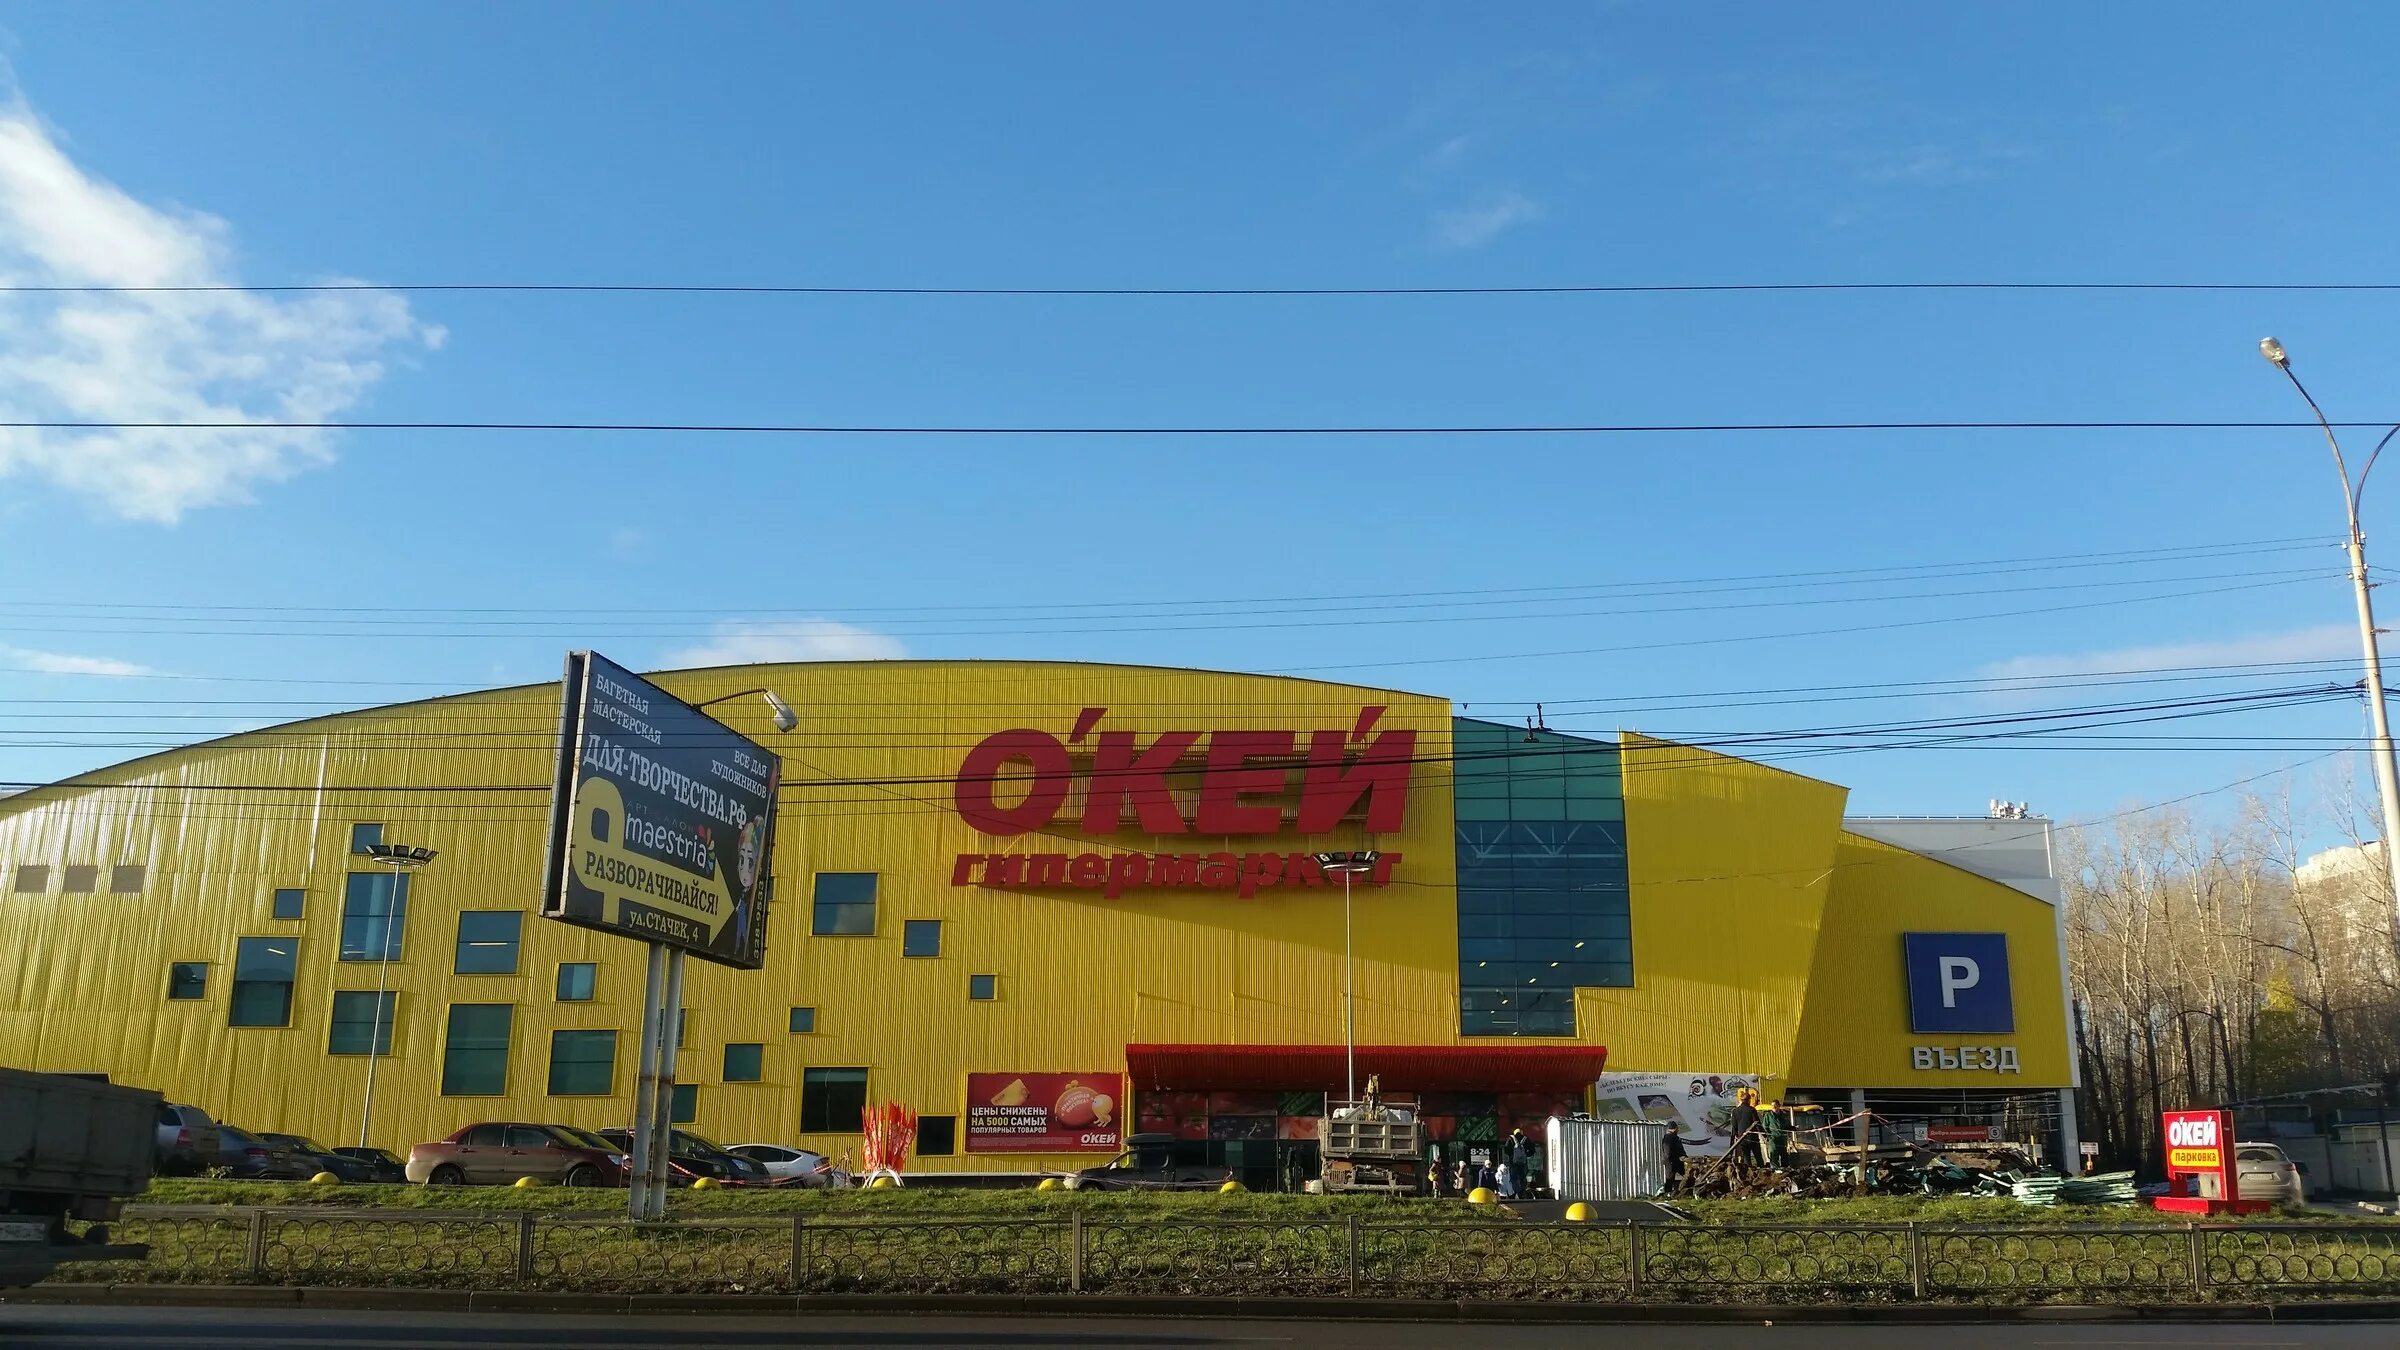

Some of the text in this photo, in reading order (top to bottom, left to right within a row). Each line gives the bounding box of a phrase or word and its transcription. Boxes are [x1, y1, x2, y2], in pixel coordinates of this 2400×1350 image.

[596, 674, 649, 715] БАГЕТНАЯ
[592, 698, 662, 744] МАСТЕРСКАЯ
[583, 733, 747, 830] ДЛЯ-ТВОРЧЕСТВА.РФ
[711, 759, 767, 799] ХУДОЖНИКОВ
[734, 750, 767, 778] ВСЕ ДЛЯ
[625, 813, 707, 869] maestria
[585, 851, 719, 916] РАЗВОРАЧИВАЙСЯ!
[1939, 956, 1980, 1008] P
[1913, 1046, 2021, 1074] ВЪЕЗД
[971, 1107, 1048, 1116] ЦЕНЫ СНИЖЕНЫ
[971, 1117, 1047, 1126] НА 5000 САМЫХ
[2175, 1152, 2217, 1164] парковка
